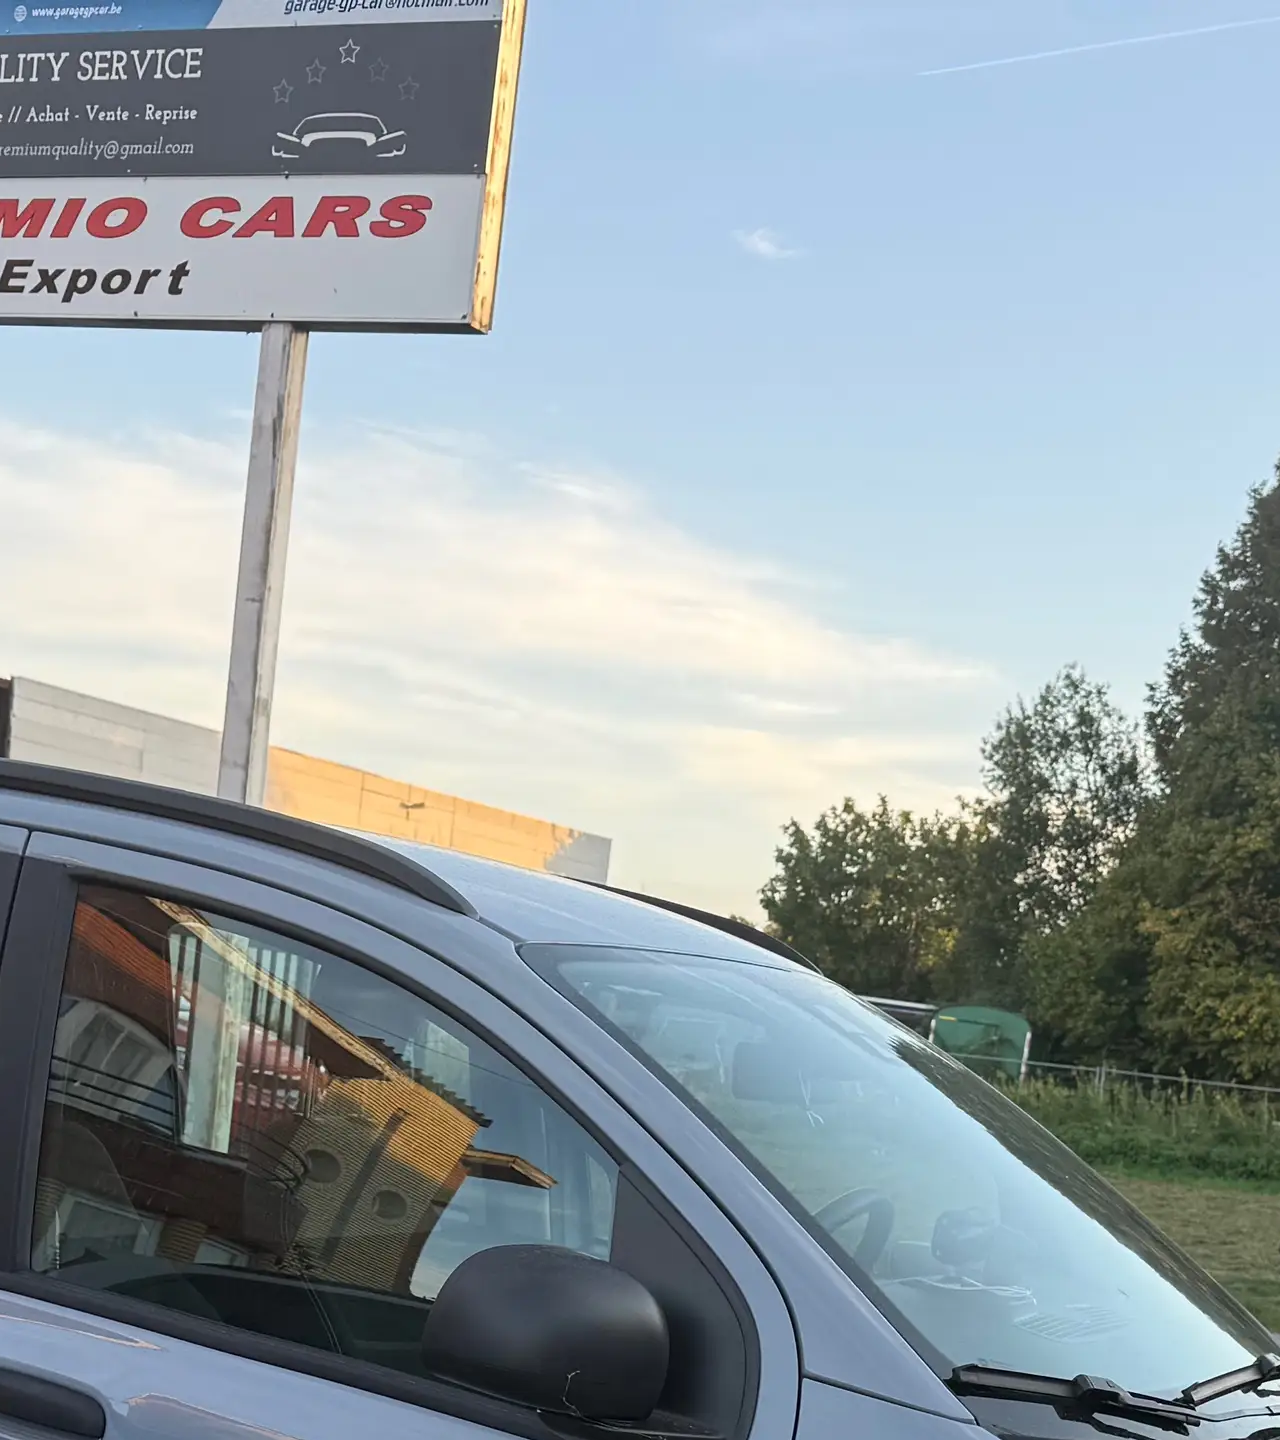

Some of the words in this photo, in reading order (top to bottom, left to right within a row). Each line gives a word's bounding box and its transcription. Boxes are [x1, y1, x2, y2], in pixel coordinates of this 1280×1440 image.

[32, 3, 122, 19] www.garagegpcar.be
[77, 48, 203, 81] SERVICE
[26, 105, 70, 122] Achat
[85, 105, 129, 121] Vente
[144, 104, 198, 124] Reprise
[179, 195, 434, 239] CARS
